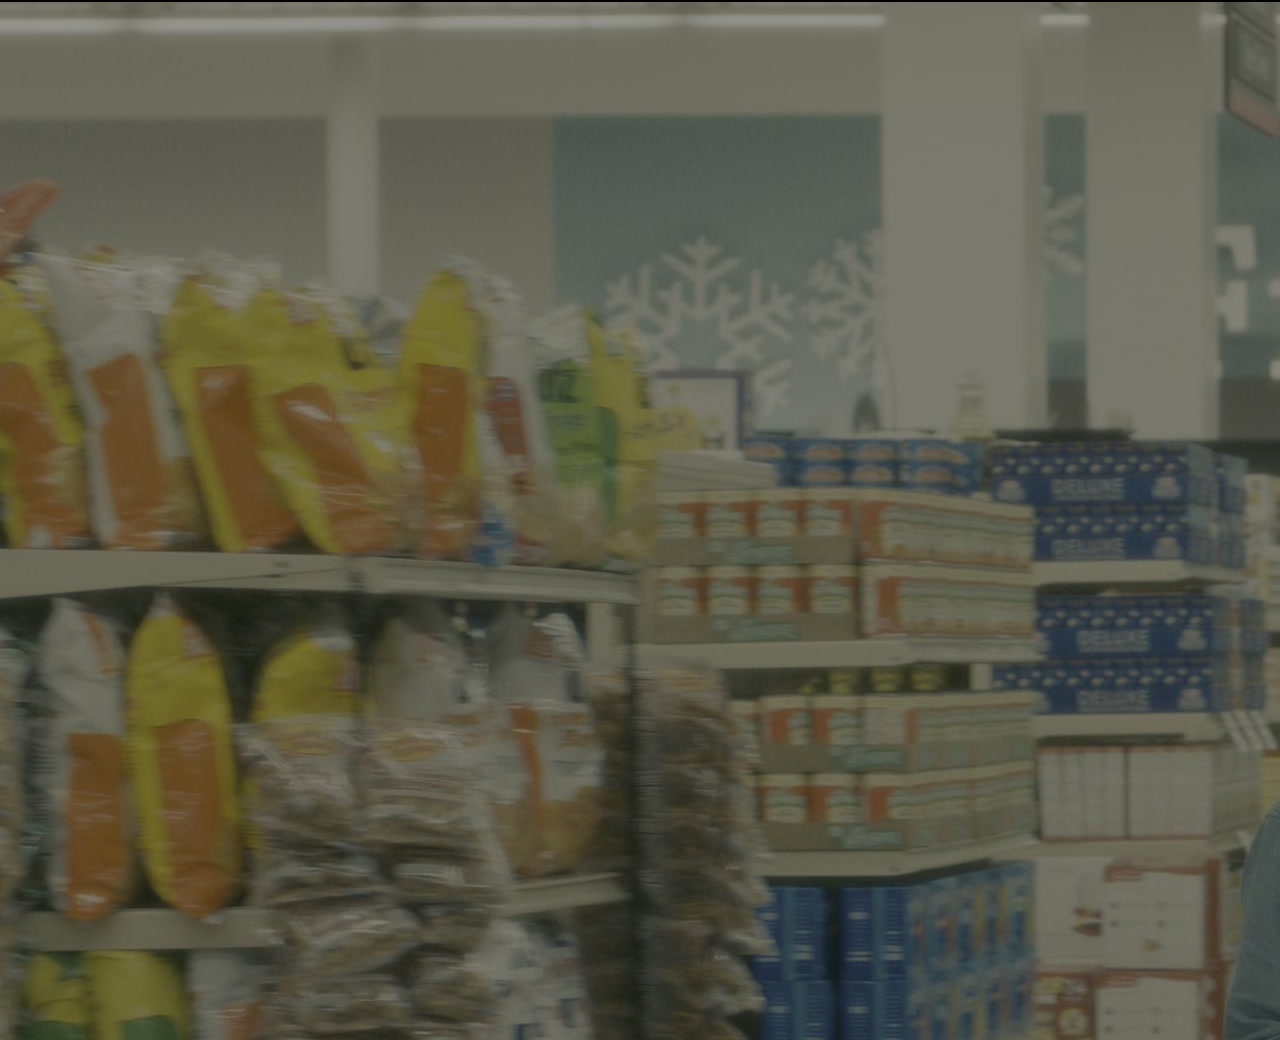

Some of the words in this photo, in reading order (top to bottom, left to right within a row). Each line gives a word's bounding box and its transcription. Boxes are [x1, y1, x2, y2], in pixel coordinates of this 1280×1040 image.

[1052, 478, 1125, 501] DELUXE
[1052, 538, 1125, 560] DELUXE
[1076, 629, 1149, 651] DELUXE
[1076, 690, 1149, 712] DELUXE
